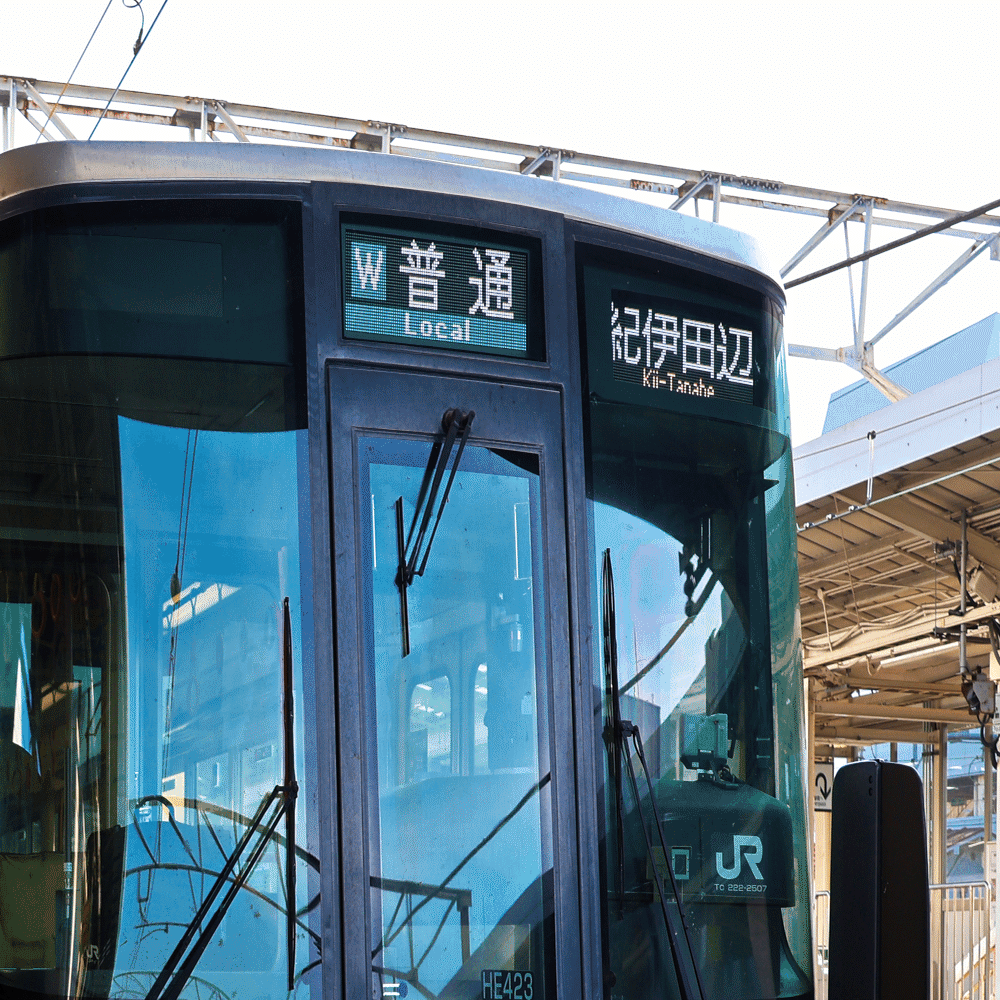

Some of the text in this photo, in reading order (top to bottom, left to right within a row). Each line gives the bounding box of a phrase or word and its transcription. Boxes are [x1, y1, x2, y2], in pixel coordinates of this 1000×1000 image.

[399, 239, 515, 319] 普通
[404, 312, 470, 341] Local
[611, 301, 754, 386] 紀伊田辺
[716, 835, 764, 880] JR
[728, 883, 767, 893] 222-2507
[482, 972, 533, 1000] HE423
